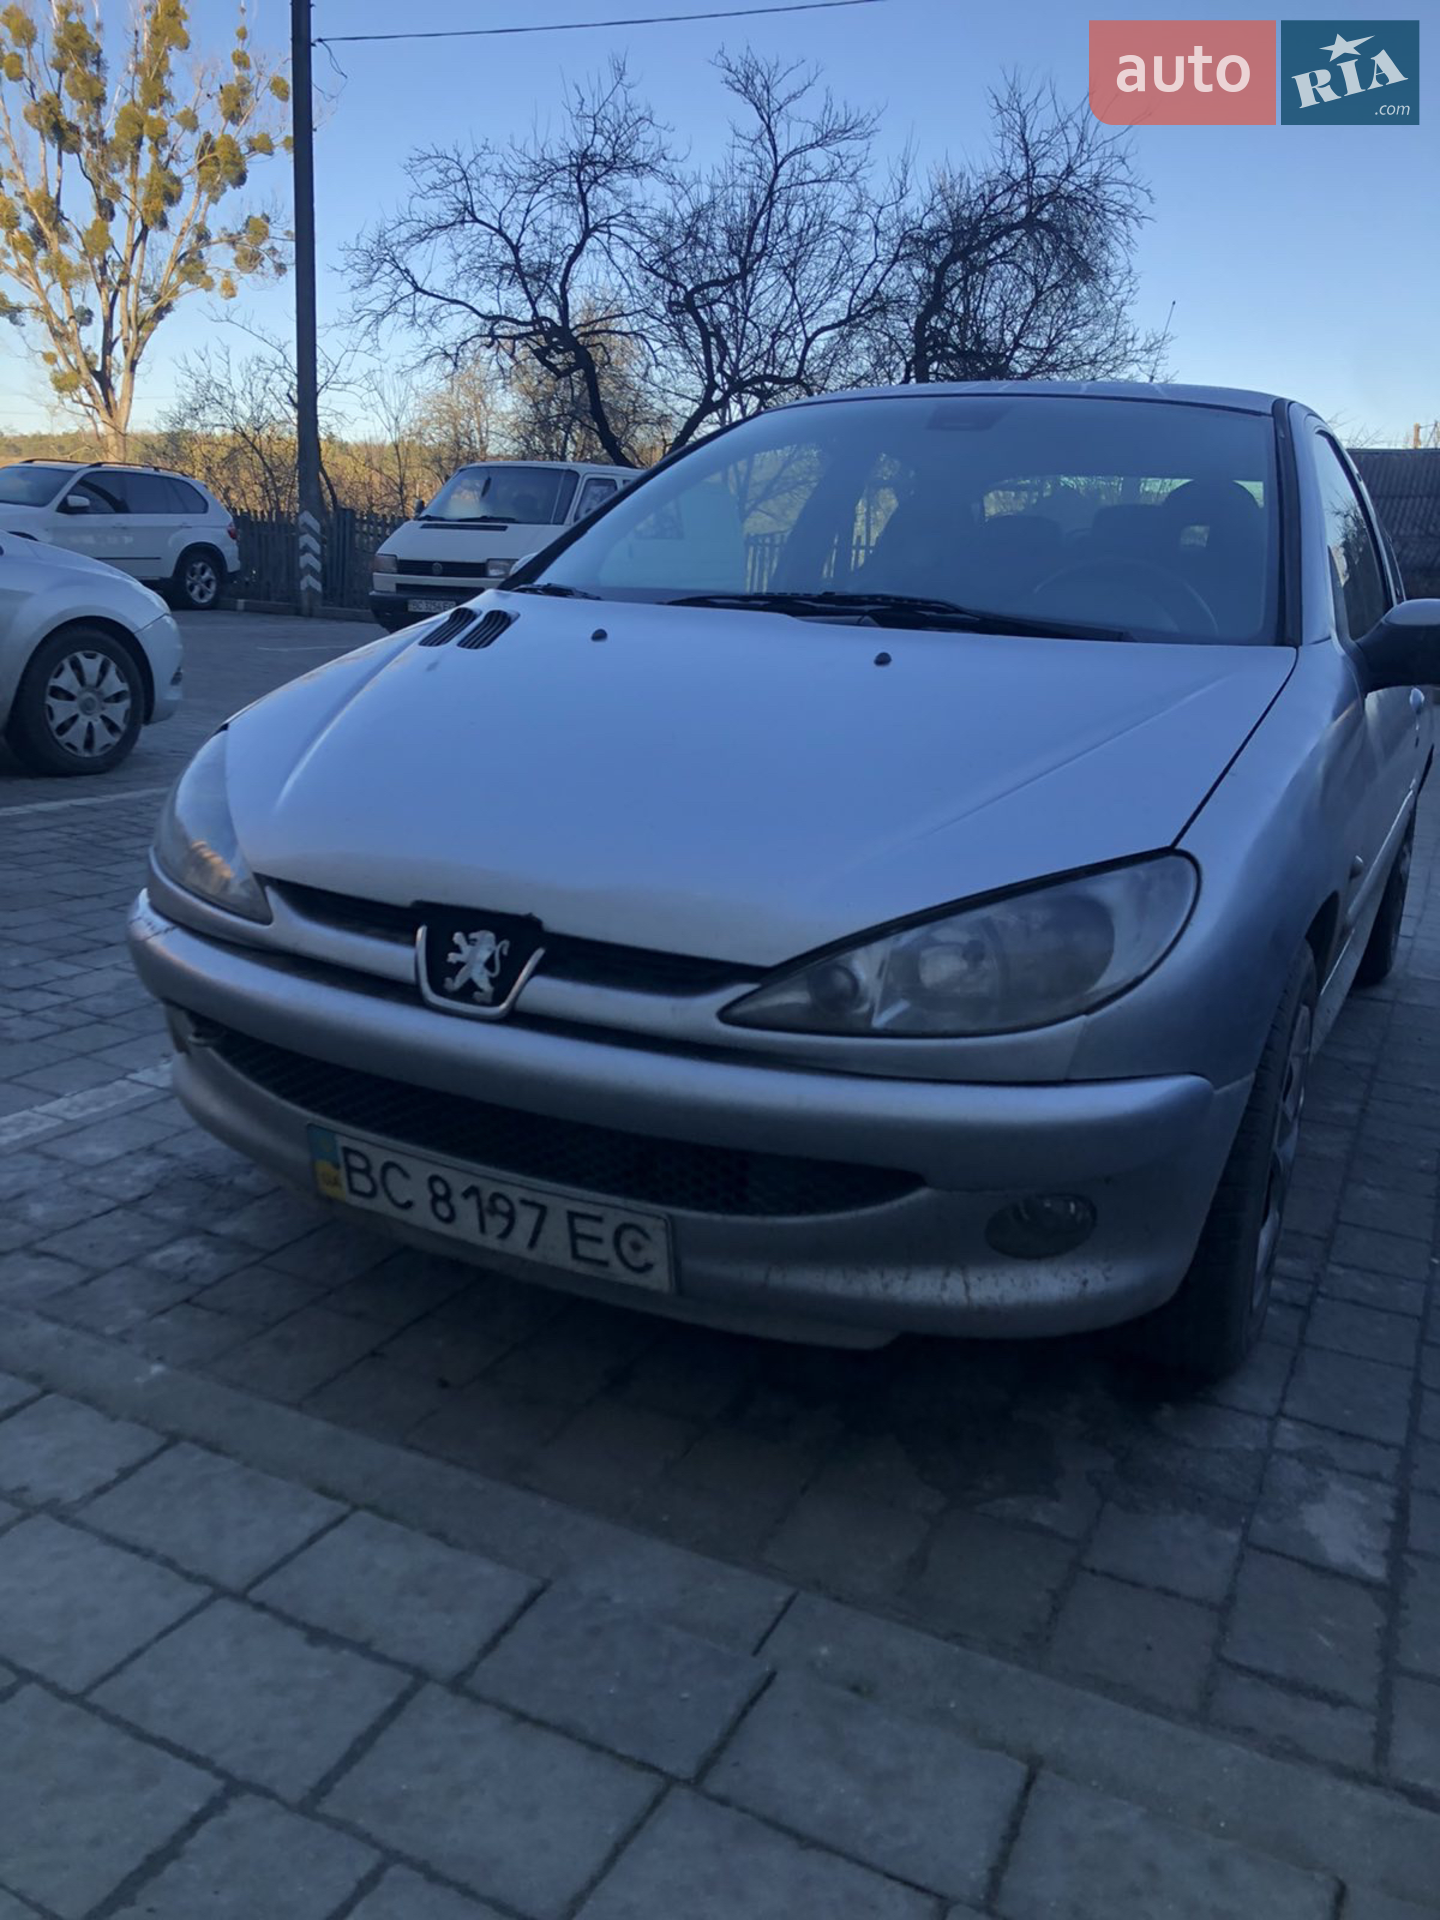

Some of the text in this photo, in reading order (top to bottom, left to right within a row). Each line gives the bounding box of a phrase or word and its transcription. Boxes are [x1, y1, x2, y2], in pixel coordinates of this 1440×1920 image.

[342, 1146, 655, 1274] BC 8197 EC
